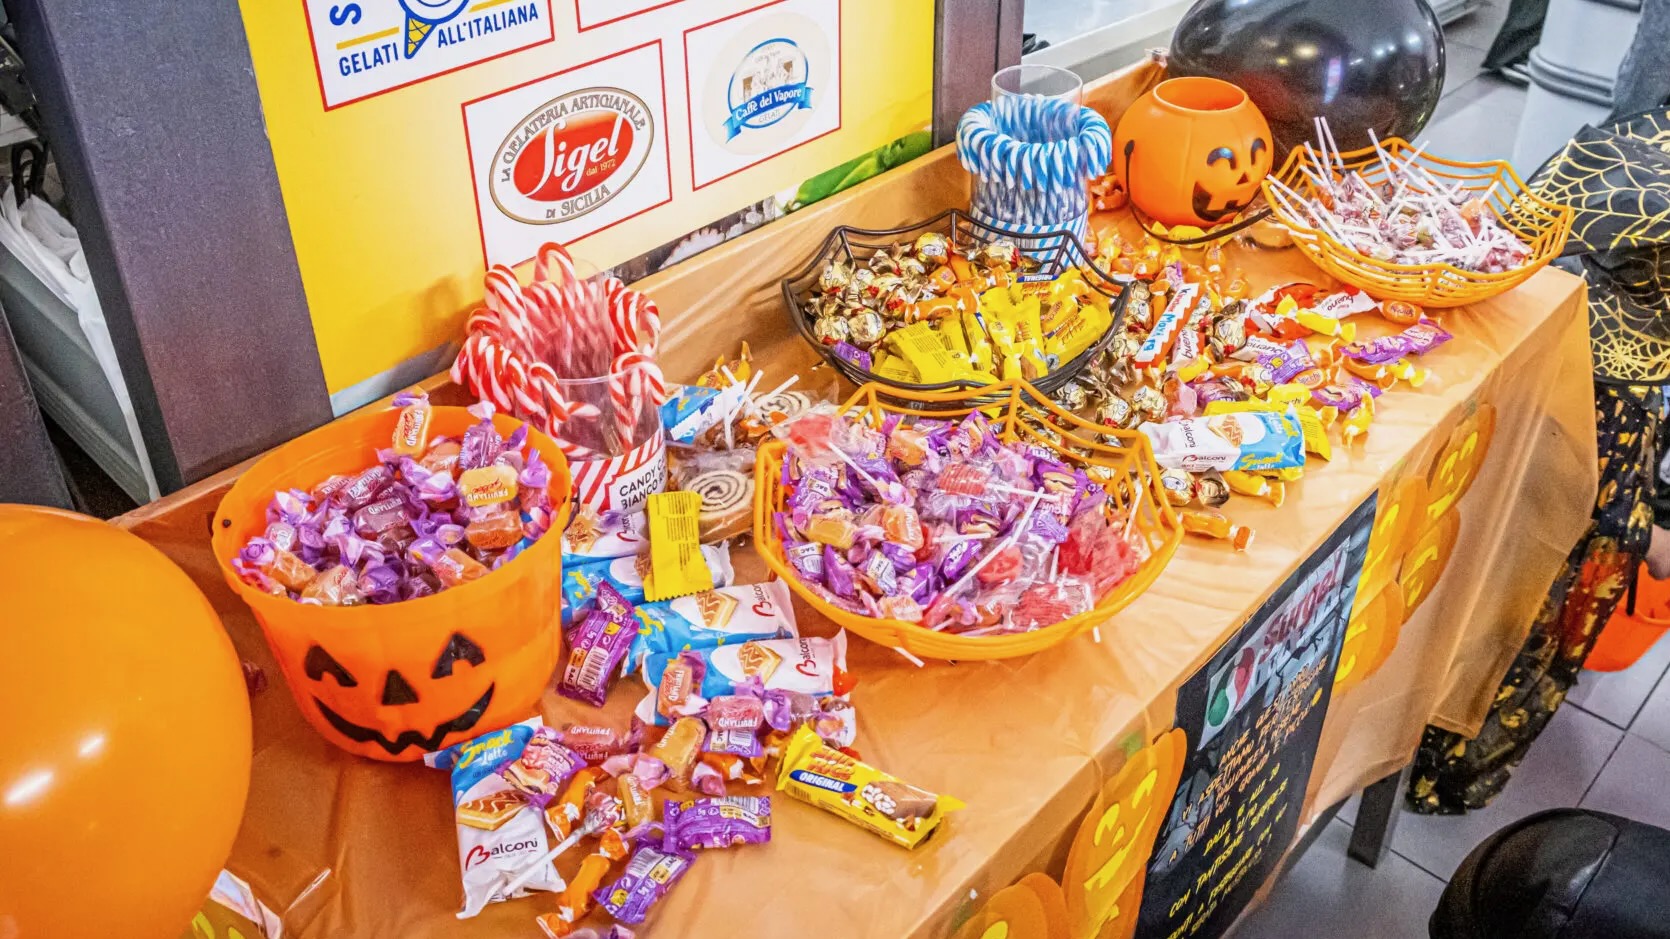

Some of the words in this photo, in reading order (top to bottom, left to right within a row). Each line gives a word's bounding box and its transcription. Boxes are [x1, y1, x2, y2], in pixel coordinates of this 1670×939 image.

[339, 42, 399, 77] GELATI
[437, 3, 539, 48] ALL'ITALIANA
[759, 94, 772, 108] del
[774, 87, 802, 103] Vapore
[570, 94, 646, 132] ARTIGIANALE
[503, 102, 569, 163] GELATERIA
[525, 112, 624, 198] Sigel
[586, 166, 598, 177] dal
[600, 158, 617, 171] 1972
[501, 167, 511, 183] LA
[546, 209, 556, 219] DI
[560, 184, 612, 217] SICILIA
[406, 408, 425, 446] FRUITLAND
[1180, 419, 1197, 448] Balconi
[1182, 454, 1227, 463] Balconi
[466, 488, 509, 502] FRUITLAND
[620, 466, 656, 497] CANDY
[620, 480, 658, 510] BIANCO
[800, 546, 815, 554] SAC
[1258, 548, 1342, 665] Surgel
[567, 669, 576, 683] SAC
[570, 726, 612, 737] FRUITLAND
[718, 717, 758, 728] FRUITLAND
[799, 772, 846, 792] ORIGINAL
[1203, 818, 1232, 856] DALLE
[465, 838, 538, 871] Balconi
[1169, 889, 1191, 918] CON
